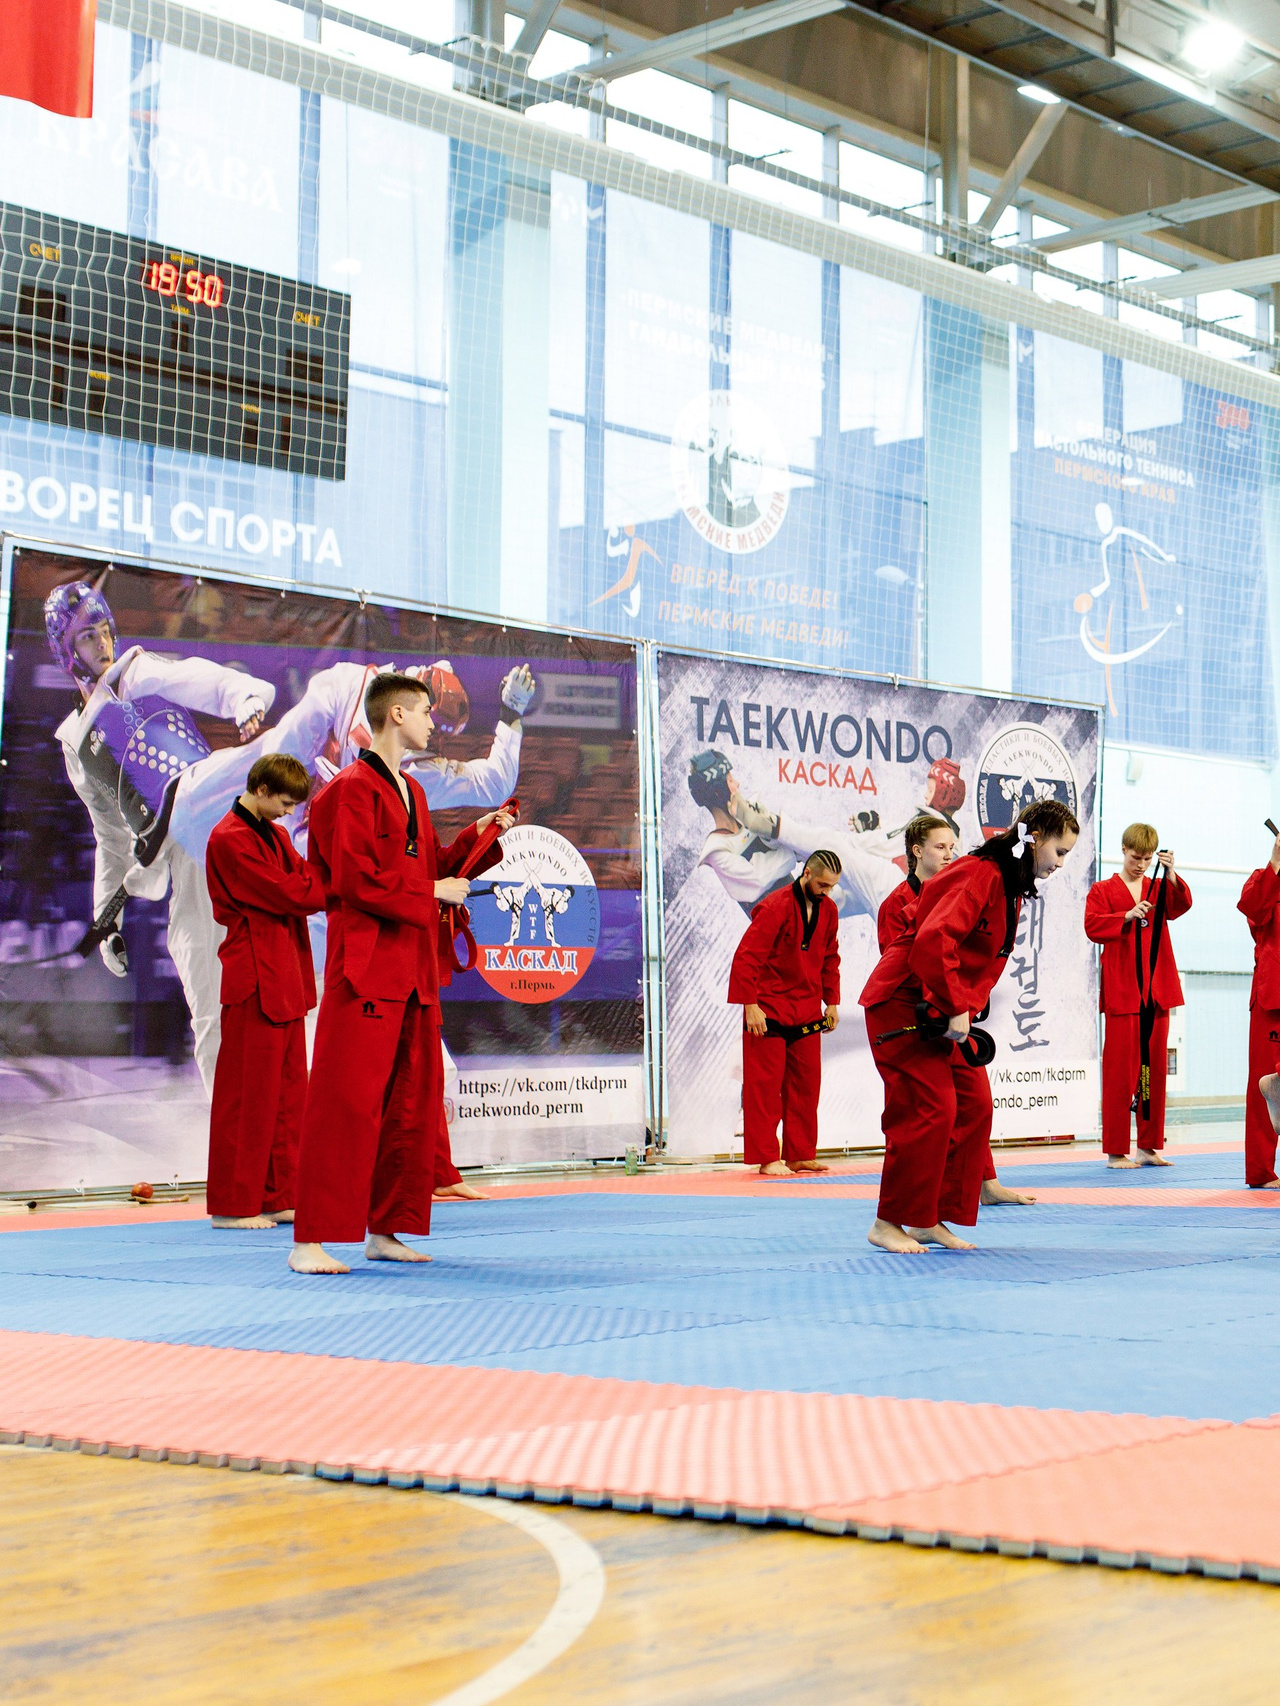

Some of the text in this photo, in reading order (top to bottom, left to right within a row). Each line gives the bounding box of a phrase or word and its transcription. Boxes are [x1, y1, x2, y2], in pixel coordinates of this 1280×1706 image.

[1136, 457, 1195, 489] ТЕННИСА
[0, 469, 342, 568] ВОРЕЦ СПОРТА
[746, 579, 759, 598] К
[764, 580, 839, 611] ПОБЕДЕ!
[658, 601, 850, 649] ПЕРМСКИЕ МЕДВЕДИ!
[690, 695, 953, 765] TAEKWONDO
[778, 758, 878, 796] КАСКАД
[1002, 749, 1055, 775] TAEKWONDO
[498, 850, 568, 877] TAEKWONDO
[540, 832, 580, 868] БОЕВЫХ
[484, 948, 579, 976] КАСКАД
[510, 979, 556, 993] г.Пермь
[459, 1076, 628, 1098] https://vk.com/tkdprm
[993, 1094, 1059, 1110] ondo_perm
[458, 1101, 584, 1119] taekwondo_perm
